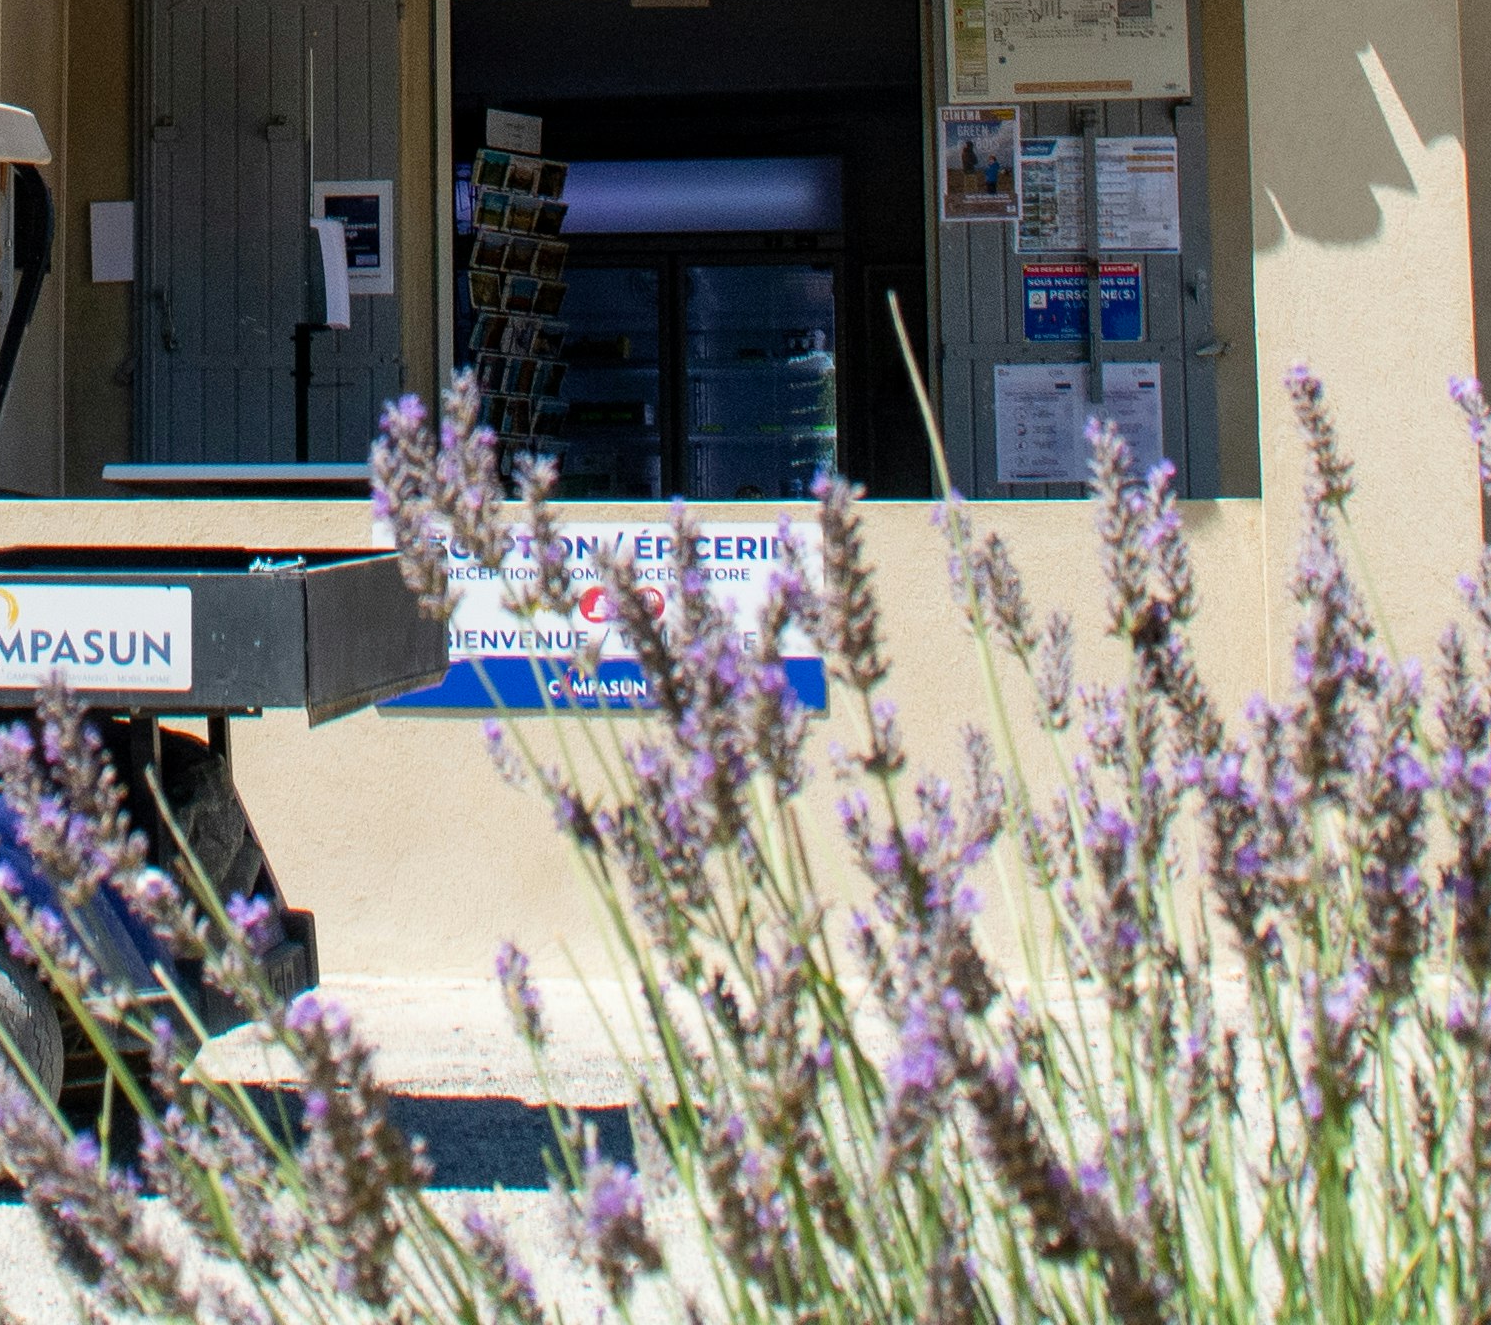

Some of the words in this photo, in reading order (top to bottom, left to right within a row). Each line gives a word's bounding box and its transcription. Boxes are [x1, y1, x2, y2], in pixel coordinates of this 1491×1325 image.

[943, 109, 981, 121] CINEMA
[957, 124, 989, 137] GREEN
[1116, 277, 1136, 286] QUE
[634, 529, 788, 561] ÉPCERIE
[447, 567, 539, 580] RECEPTION
